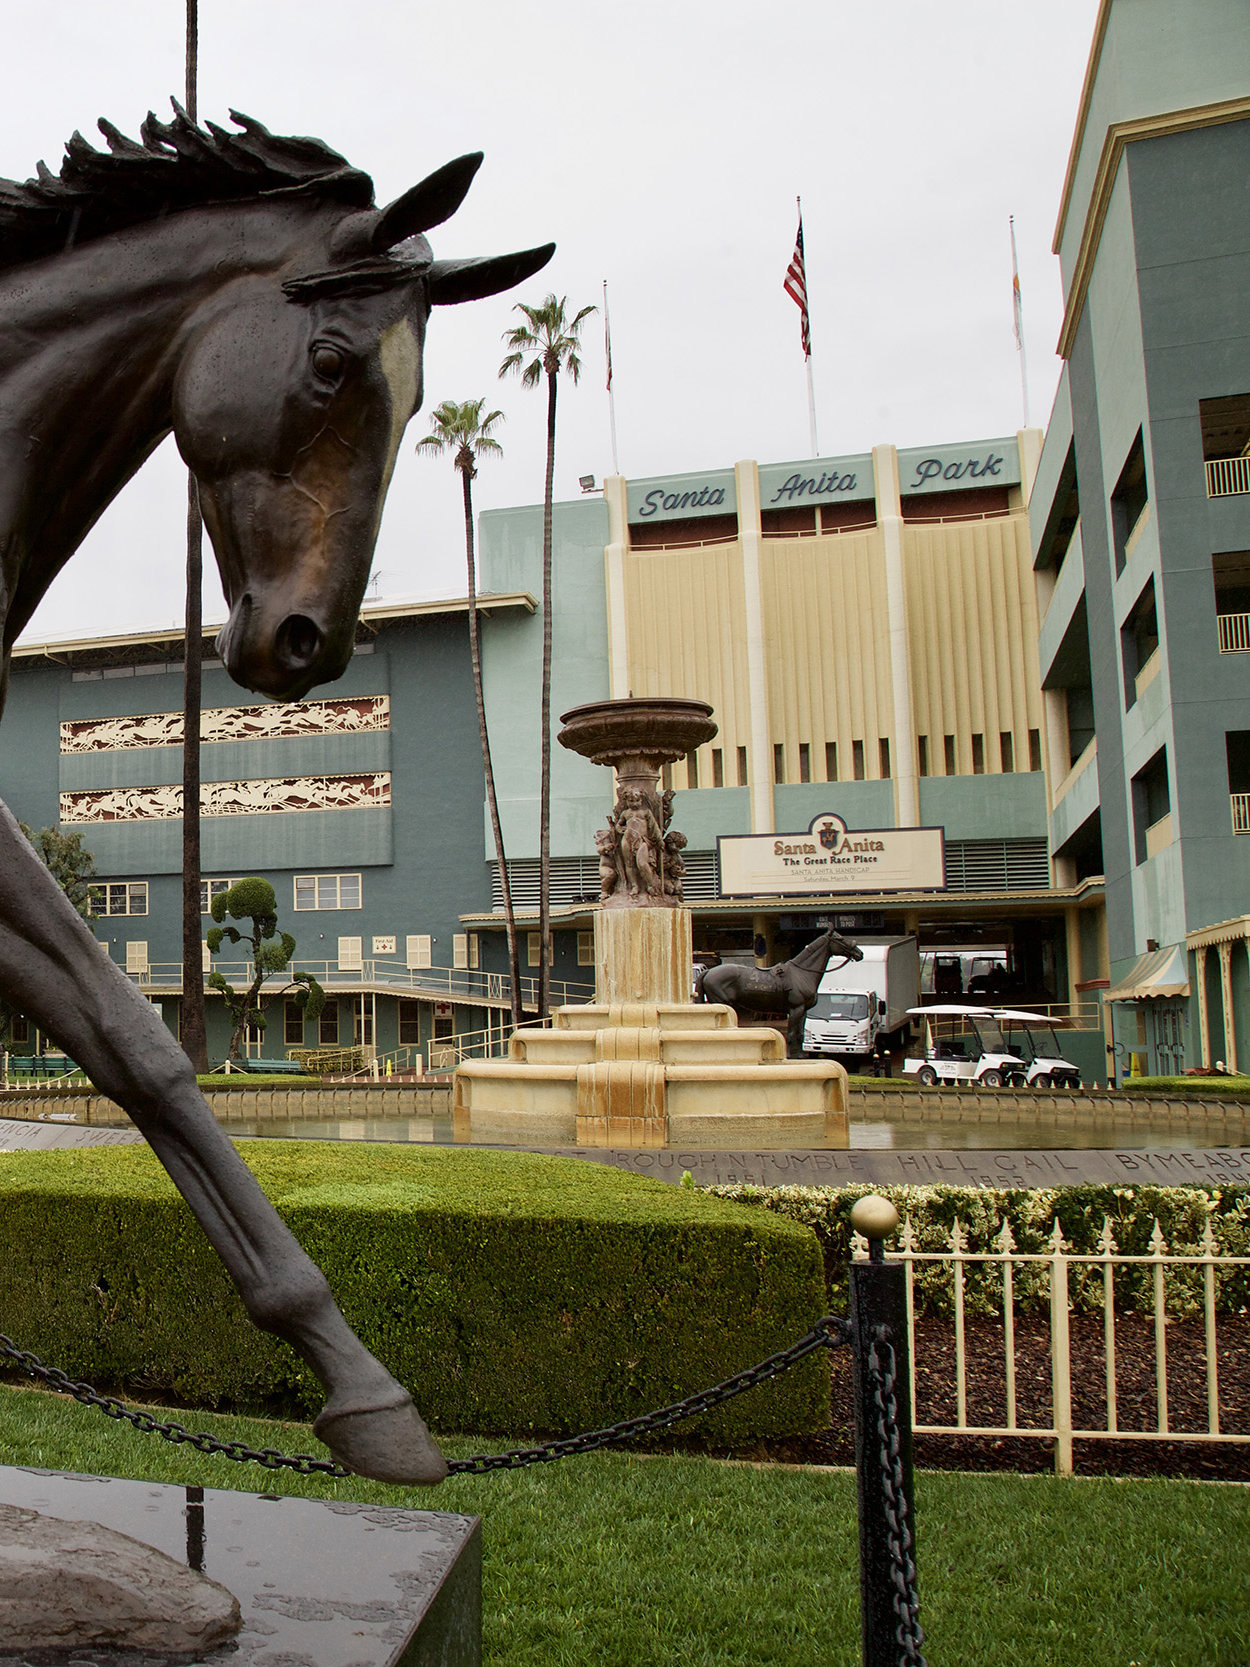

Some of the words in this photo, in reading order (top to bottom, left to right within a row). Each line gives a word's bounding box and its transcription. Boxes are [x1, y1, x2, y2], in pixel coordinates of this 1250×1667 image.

[639, 486, 726, 517] Santa
[770, 470, 857, 502] Anita
[910, 453, 1004, 488] Park
[773, 840, 817, 856] Santa
[831, 837, 885, 856] Anita
[783, 857, 800, 865] The
[803, 857, 827, 865] Great
[830, 856, 851, 864] Race
[853, 855, 878, 863] Place
[835, 866, 870, 874] HANDICAP
[616, 1153, 719, 1169] ROUGH
[754, 1154, 865, 1170] TUMBLE
[897, 1155, 978, 1171] HILL
[993, 1154, 1079, 1171] GAIL
[970, 1175, 1028, 1187] 1952
[1206, 1173, 1250, 1185] 194
